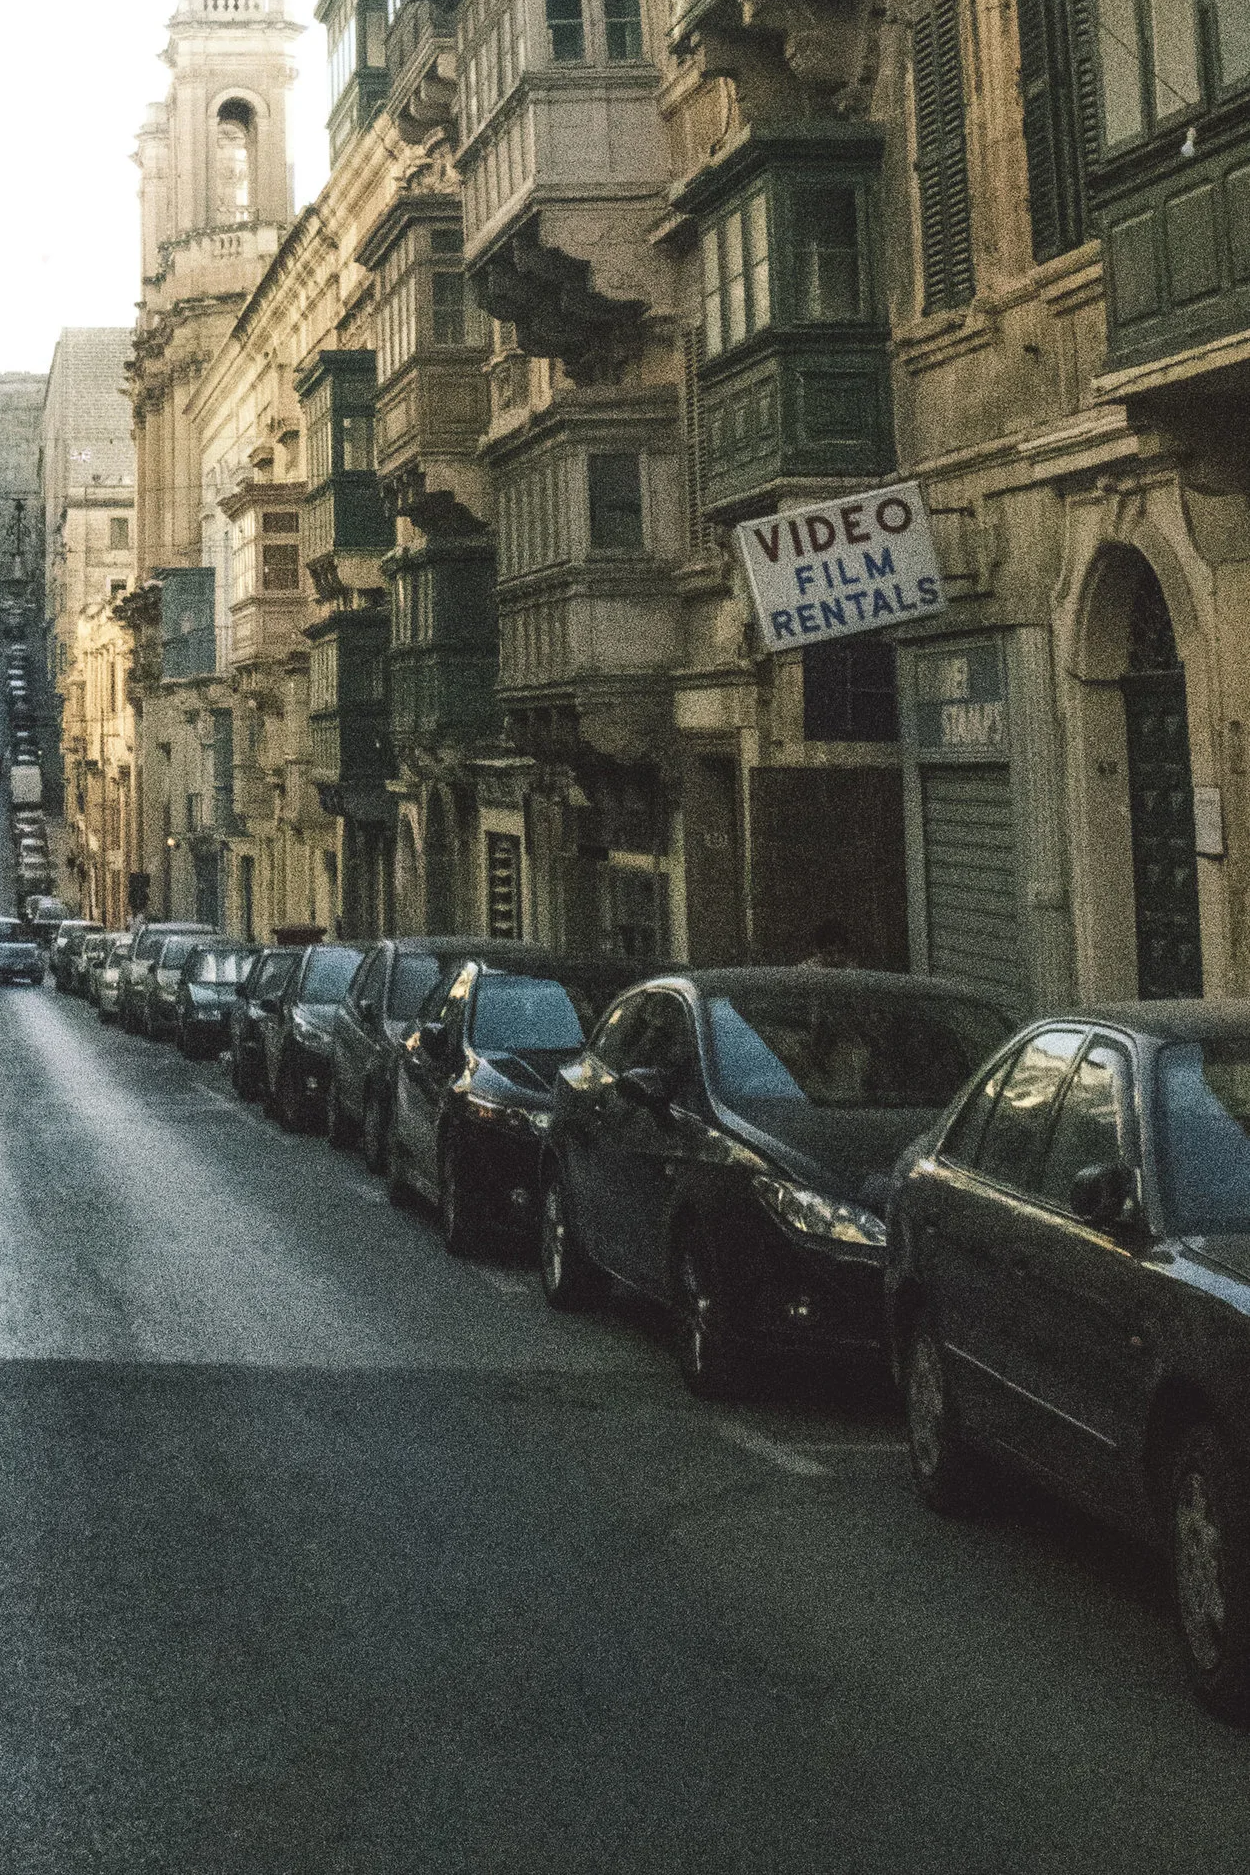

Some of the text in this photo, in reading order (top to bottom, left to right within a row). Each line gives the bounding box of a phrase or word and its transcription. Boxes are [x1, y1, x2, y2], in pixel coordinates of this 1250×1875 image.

[754, 497, 912, 563] VIDEO
[794, 547, 895, 595] FILM
[771, 577, 938, 640] RENTALS
